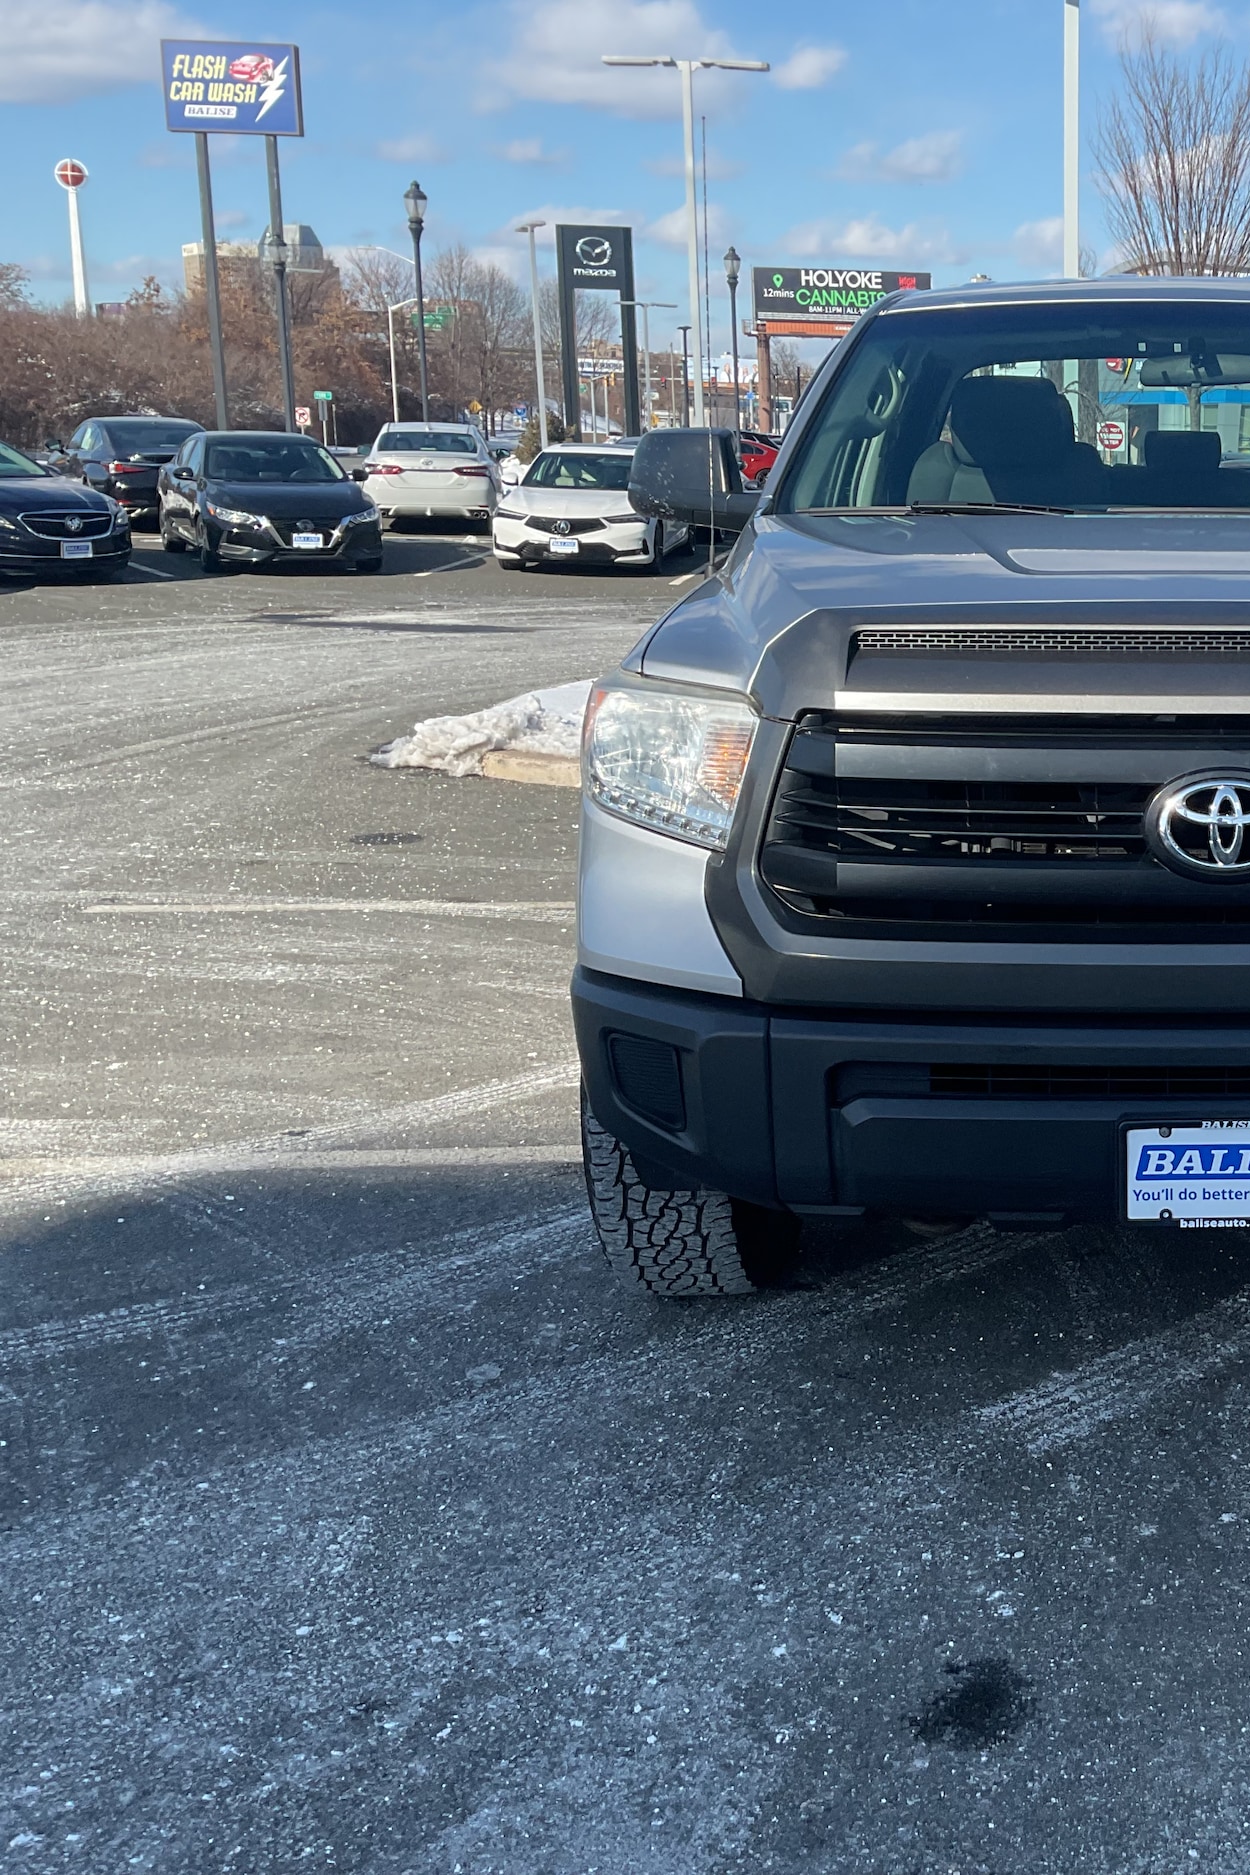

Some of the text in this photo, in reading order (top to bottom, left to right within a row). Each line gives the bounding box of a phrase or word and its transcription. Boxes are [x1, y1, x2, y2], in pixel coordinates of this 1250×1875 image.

[172, 54, 227, 79] FLASH
[169, 81, 257, 103] CAR WASH
[187, 106, 235, 117] BALISE
[573, 268, 617, 277] mazda
[800, 269, 882, 289] HOLYOKE
[763, 288, 795, 298] 12mins
[808, 306, 843, 314] 8AM-11PM
[1133, 1188, 1173, 1201] You'll
[1178, 1188, 1197, 1201] do
[1202, 1188, 1250, 1200] better
